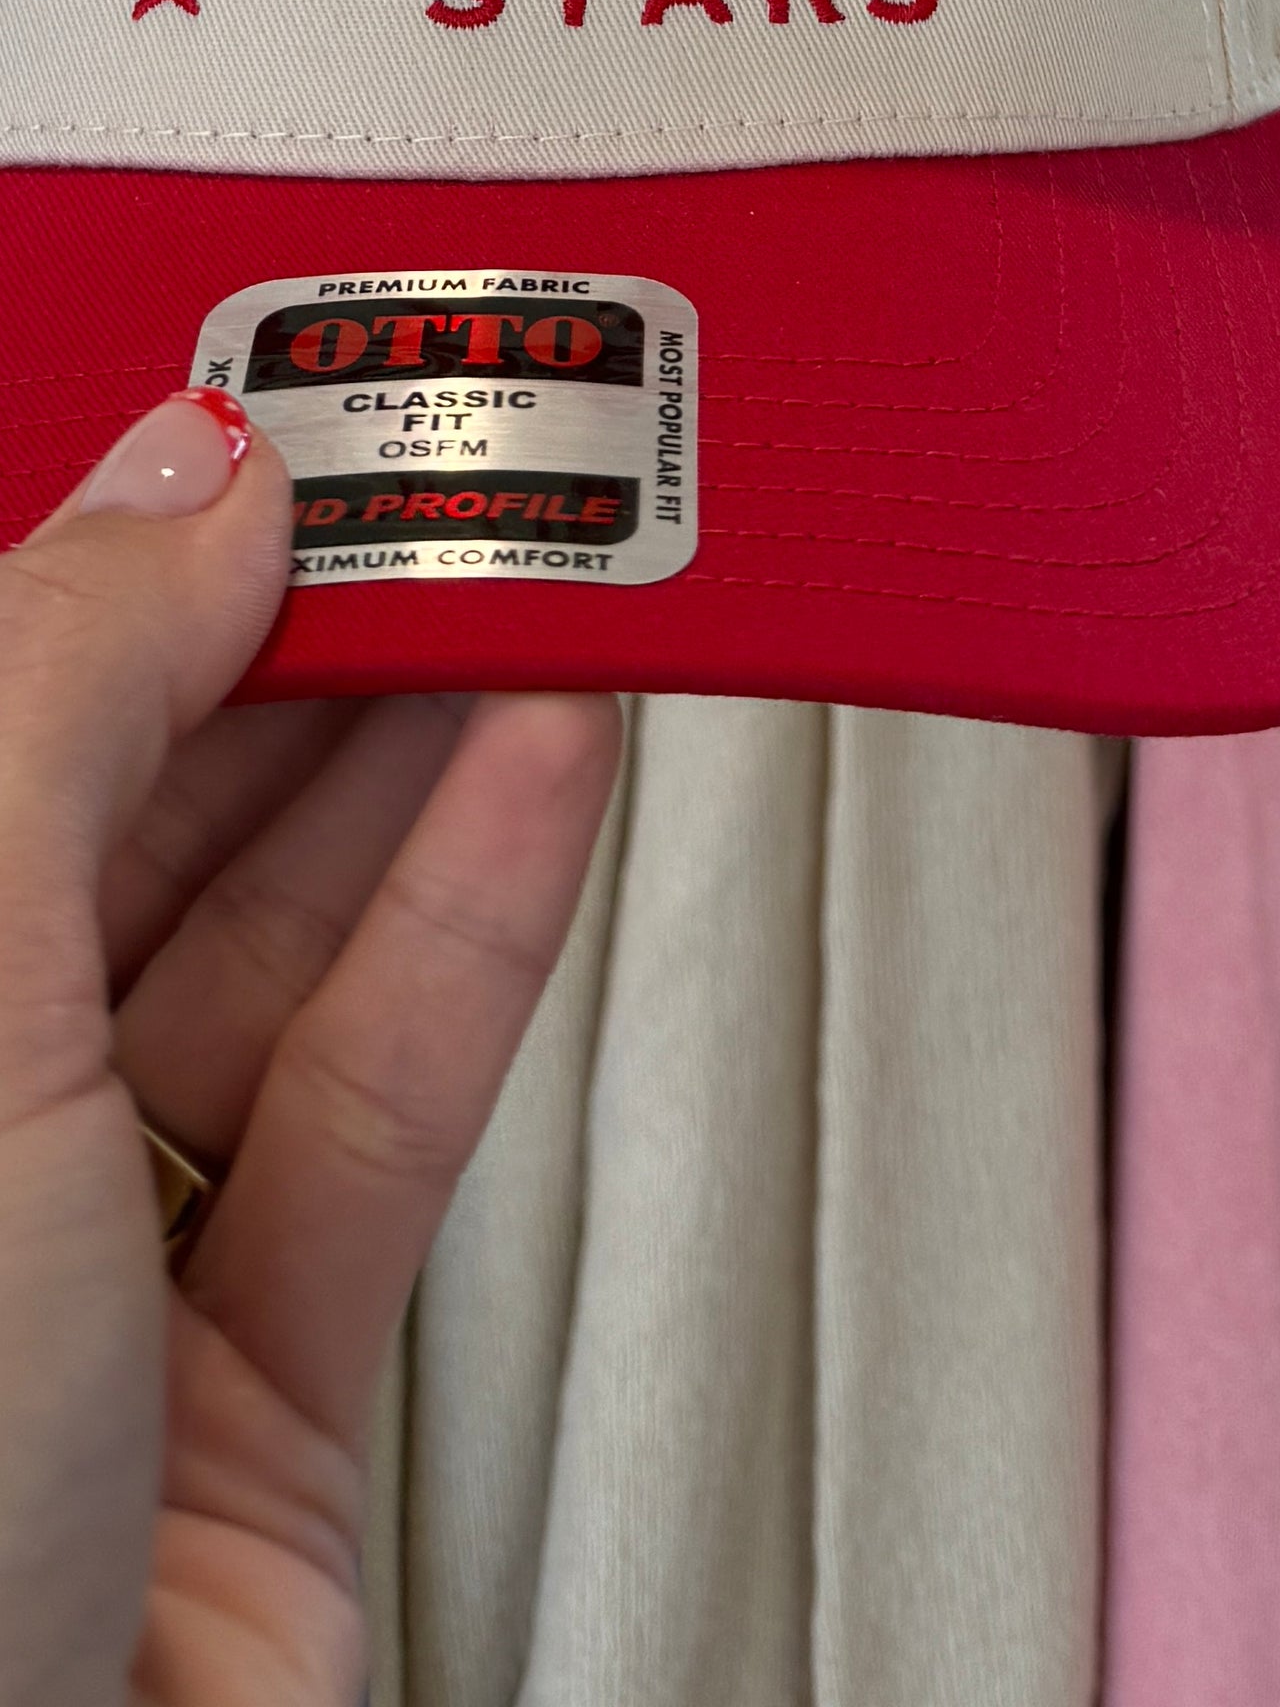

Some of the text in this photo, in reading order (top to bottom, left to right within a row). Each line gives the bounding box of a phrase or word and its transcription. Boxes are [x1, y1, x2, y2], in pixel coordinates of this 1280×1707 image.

[318, 278, 590, 296] PREMIUM FABRIC
[290, 314, 602, 373] OTTO
[343, 391, 537, 413] CLASSIC
[402, 413, 472, 432] FIT
[655, 330, 684, 525] MOST POPULAR FIT
[378, 439, 488, 459] OSFM
[293, 492, 621, 527] ID PROFILE
[290, 549, 614, 574] XIMUM COMFORT
